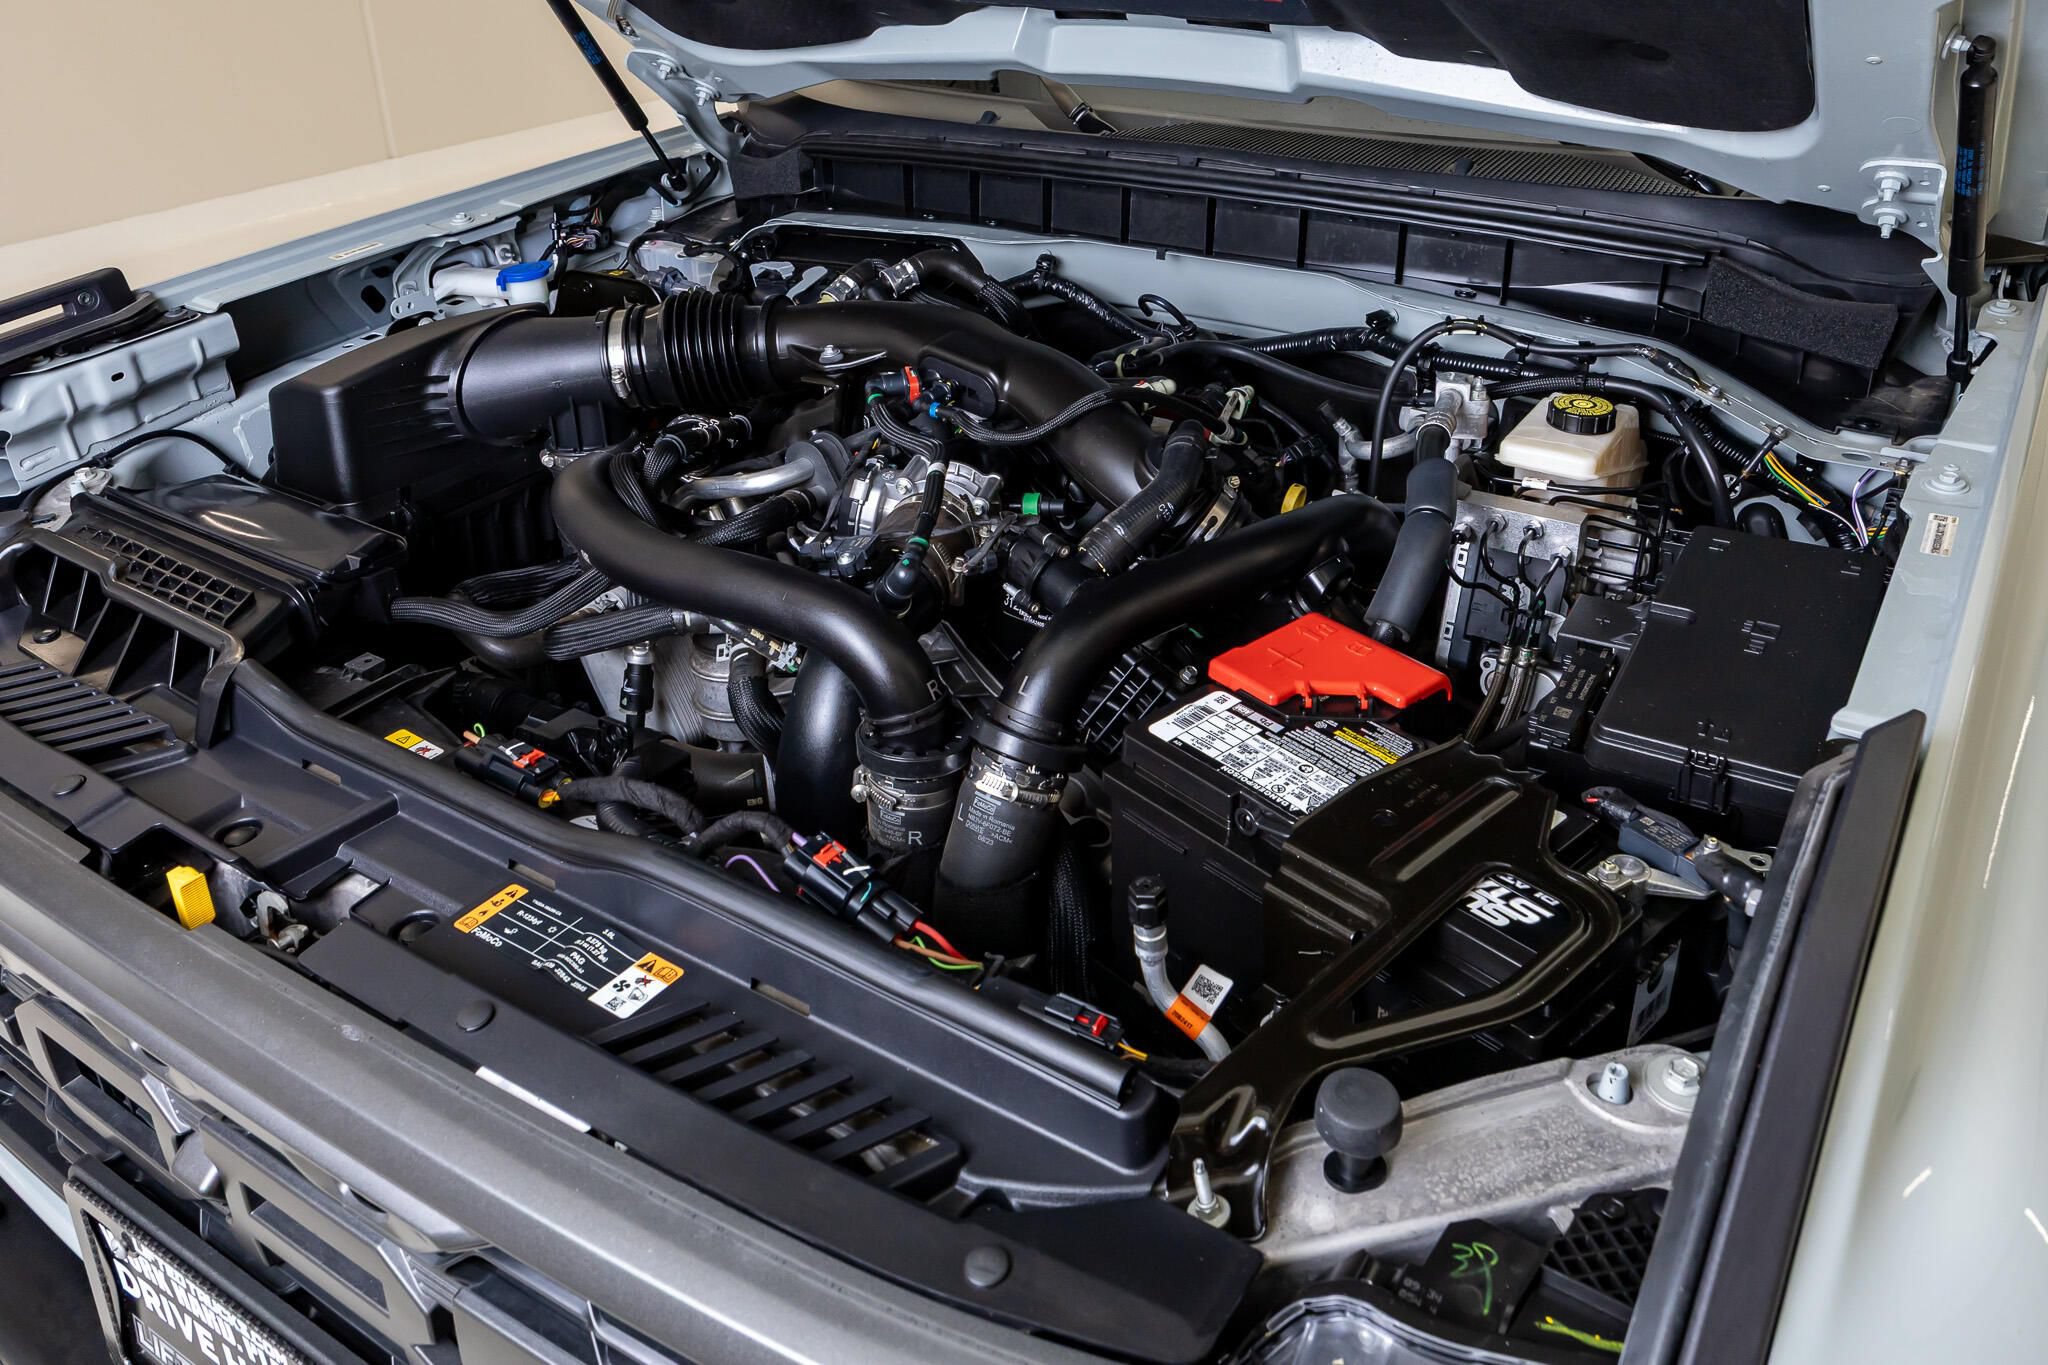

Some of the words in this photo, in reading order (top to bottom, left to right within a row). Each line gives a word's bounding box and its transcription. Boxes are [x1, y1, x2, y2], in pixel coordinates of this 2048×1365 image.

[926, 680, 943, 700] R
[1018, 675, 1031, 697] L
[1257, 717, 1273, 726] Pb
[957, 803, 964, 822] L
[988, 814, 1016, 829] Romania
[908, 831, 923, 846] R
[471, 927, 503, 948] FoMoCo
[568, 950, 586, 965] PAG
[113, 1259, 220, 1365] DRIVE
